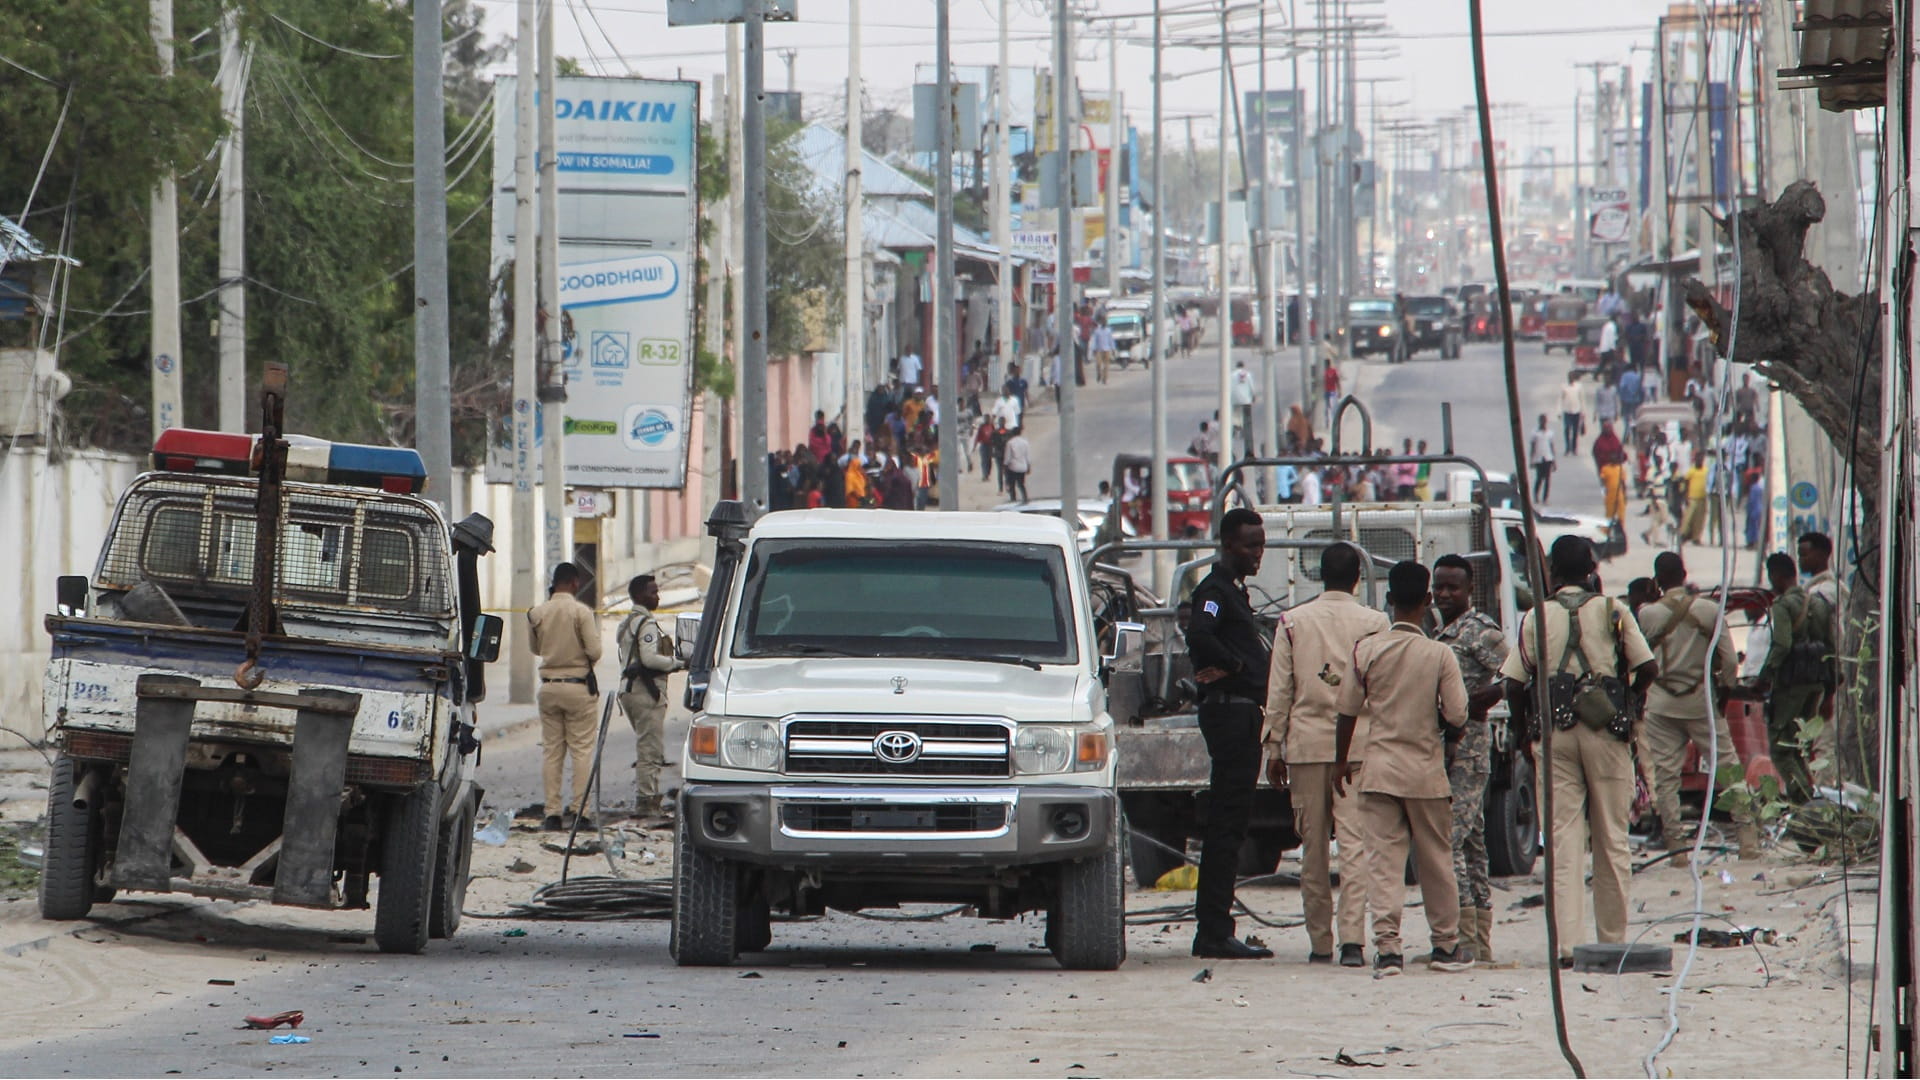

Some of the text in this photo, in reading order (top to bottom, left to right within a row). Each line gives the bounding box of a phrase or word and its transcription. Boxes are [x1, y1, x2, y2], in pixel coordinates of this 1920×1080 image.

[555, 98, 676, 123] DAIKIN
[556, 154, 651, 169] OW IN SOMALIA!
[641, 344, 678, 360] R-32
